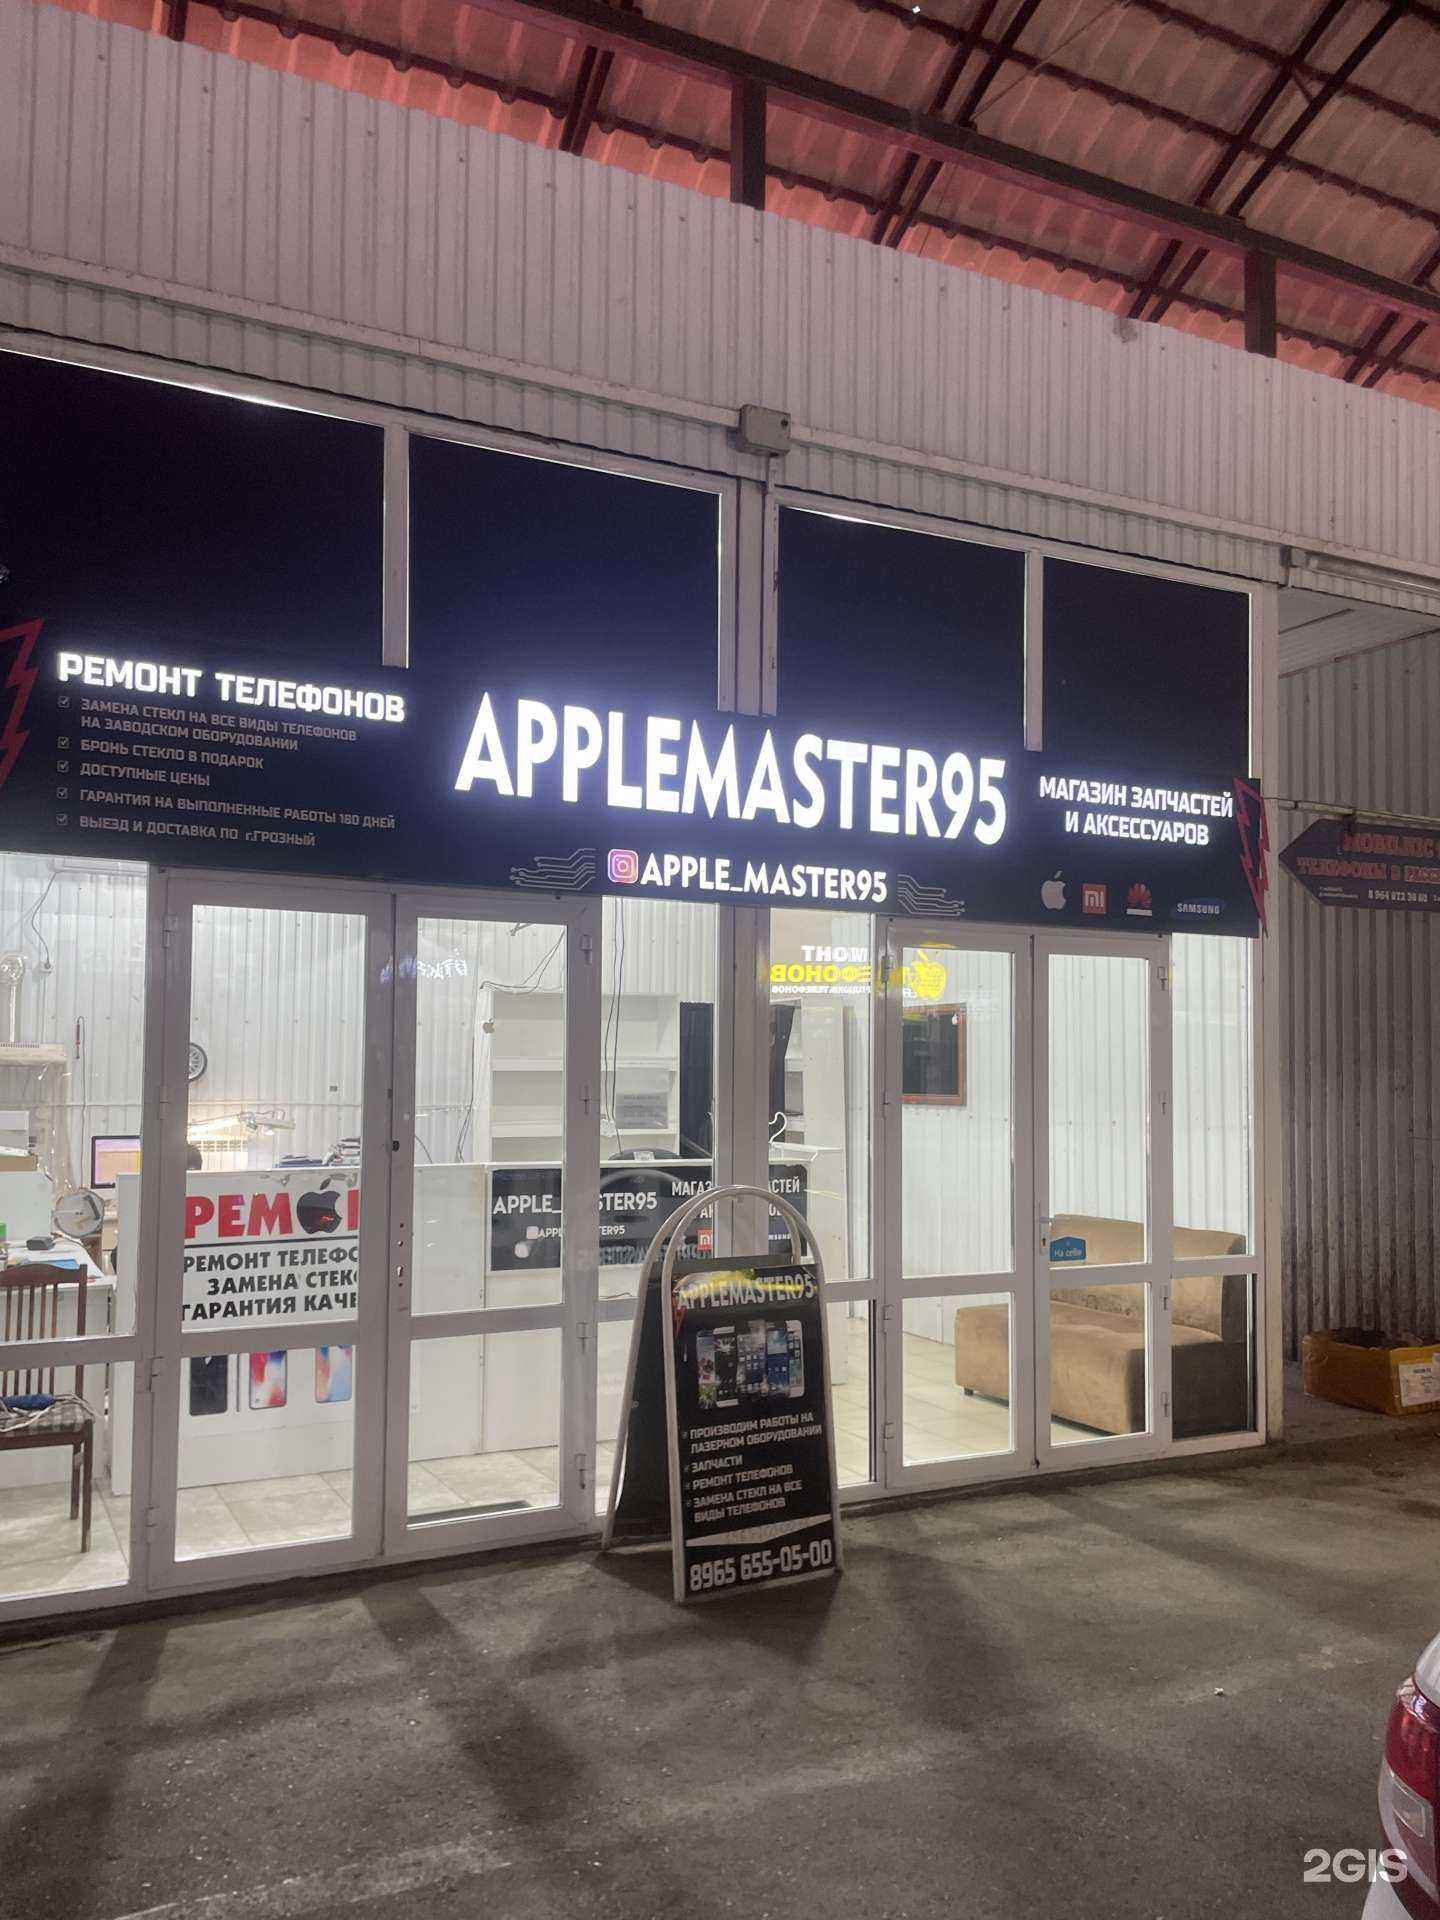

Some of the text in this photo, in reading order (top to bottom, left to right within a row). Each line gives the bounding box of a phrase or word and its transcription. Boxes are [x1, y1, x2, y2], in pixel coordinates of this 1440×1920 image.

[58, 652, 406, 722] РЕМОНТ ТЕЛЕФОНОВ
[81, 699, 357, 741] ЗАМЕНА СТЕКЛ НА ВСЕ ВИДЫ ТЕЛЕФОНОВ
[81, 716, 298, 750] НА ЗАВОДСКОМ ОБОРУДОВАНИИ
[80, 739, 264, 769] БРОНЬ СТЕКЛО В ПОДАРОК
[454, 691, 1007, 845] APPLEMASTER95
[80, 763, 210, 786] ДОСТУПНЫЕ ЦЕНЫ
[80, 789, 150, 806] ГАРАНТИЯ
[155, 797, 173, 809] НА
[177, 799, 280, 818] ВЫПОЛНЕННЫЕ
[284, 808, 336, 824] РАБОТЫ
[363, 815, 396, 829] ДНЕЙ
[1039, 775, 1234, 819] МАГАЗИН ЗАПЧАСТЕЙ
[80, 815, 129, 832] ВЫЕЗД
[133, 821, 142, 832] И
[146, 821, 216, 837] ДОСТАВКА
[220, 828, 239, 840] ПО
[1065, 811, 1209, 847] И АКСЕССУАРОВ
[640, 852, 887, 903] APPLE_MASTER95
[1177, 903, 1220, 915] SAMSUNG
[184, 1251, 271, 1273] РЕМОНТ
[207, 1273, 298, 1296] ЗАМЕНА
[690, 1412, 814, 1440] ПРОИЗВОДИМ РАБОТЫ НА
[691, 1424, 822, 1454] ЛАЗЕРНОМ ОБОРУДОВАНИИ
[691, 1455, 743, 1473] ЗАПЧАСТИ
[693, 1464, 794, 1490] РЕМОНТ ТЕЛЕФОНОВ
[694, 1480, 802, 1508] ЗАМЕНА СТЕКЛ НА ВСЕ
[694, 1498, 786, 1523] ВИДЫ ТЕЛЕФОНОВ
[689, 1538, 833, 1592] 8965 655-05-00
